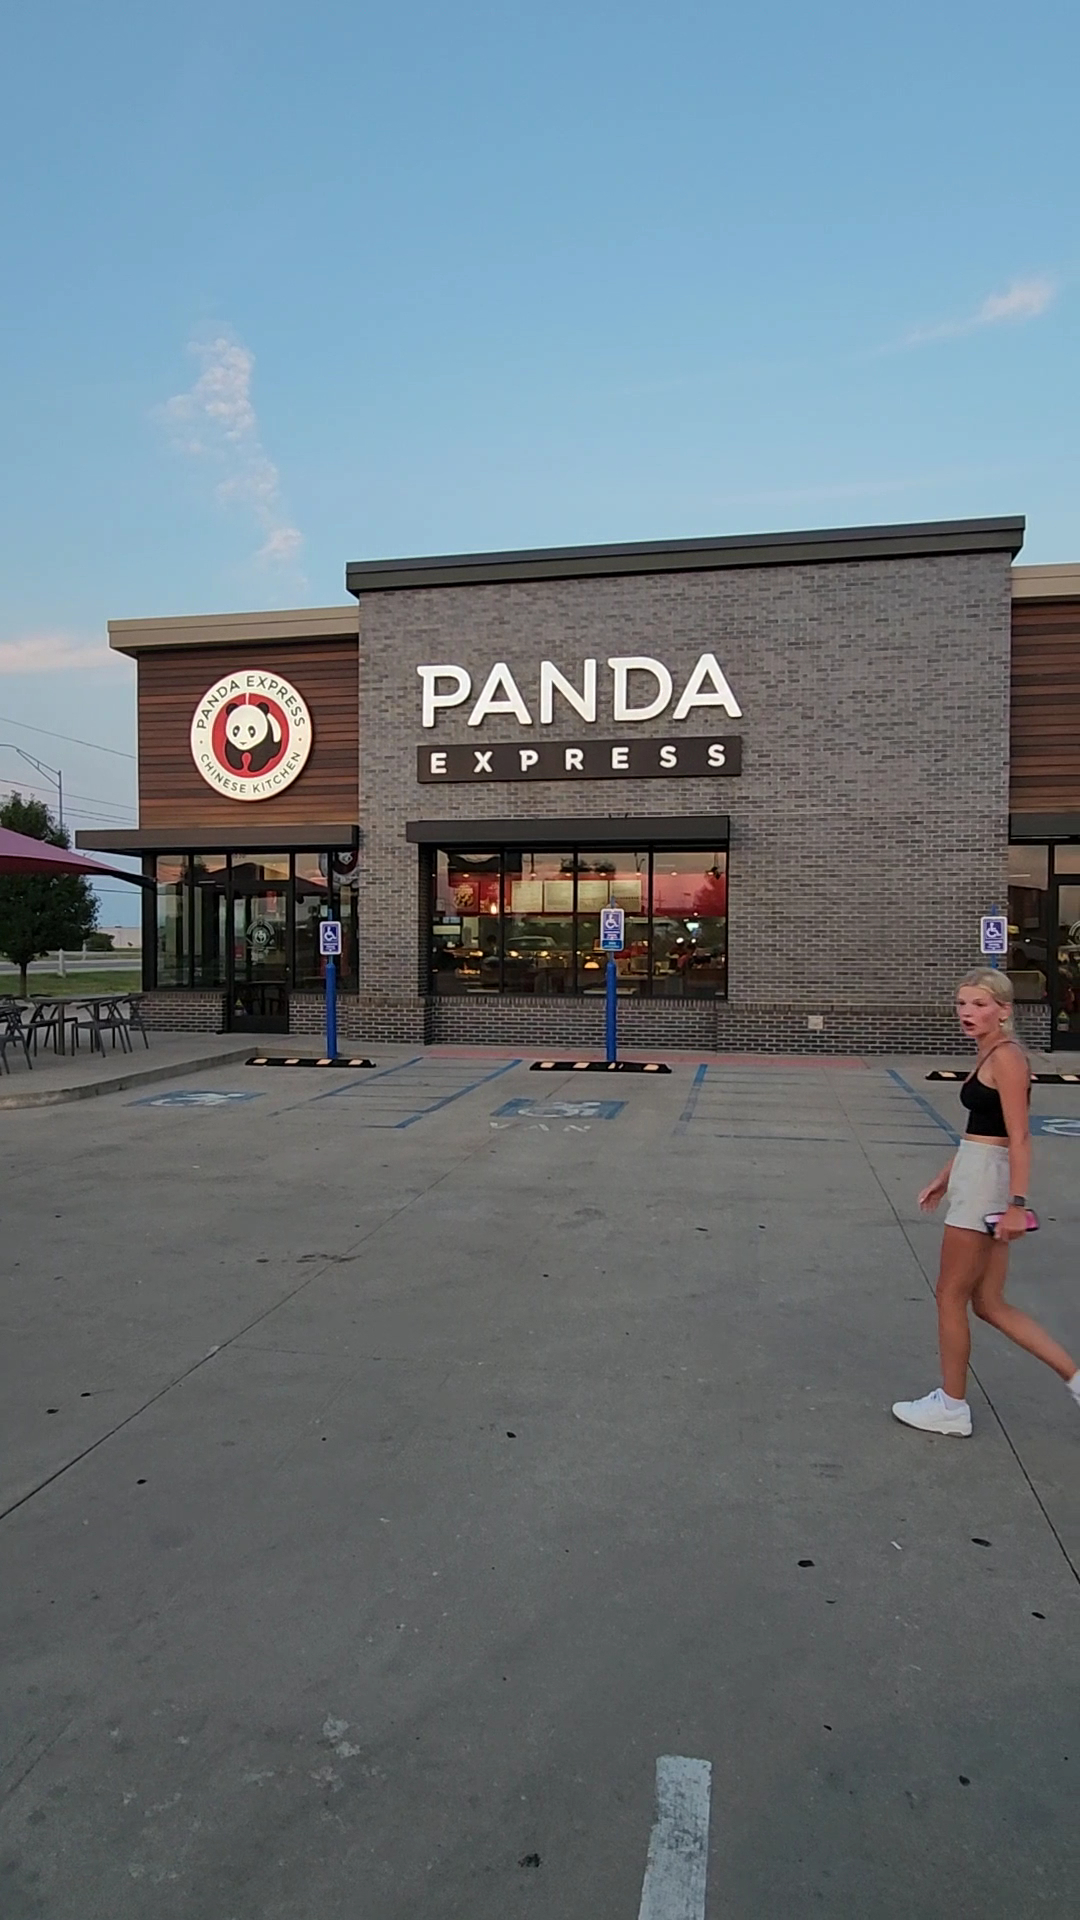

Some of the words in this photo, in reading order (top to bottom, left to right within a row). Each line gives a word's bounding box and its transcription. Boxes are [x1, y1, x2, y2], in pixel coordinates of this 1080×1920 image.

[196, 679, 241, 730] PANDA
[246, 675, 305, 727] EXPRESS
[416, 653, 743, 728] PANDA
[200, 753, 247, 794] CHINESE
[252, 751, 301, 794] KITCHEN
[430, 743, 726, 774] EXPRESS
[489, 1121, 592, 1133] VAN
